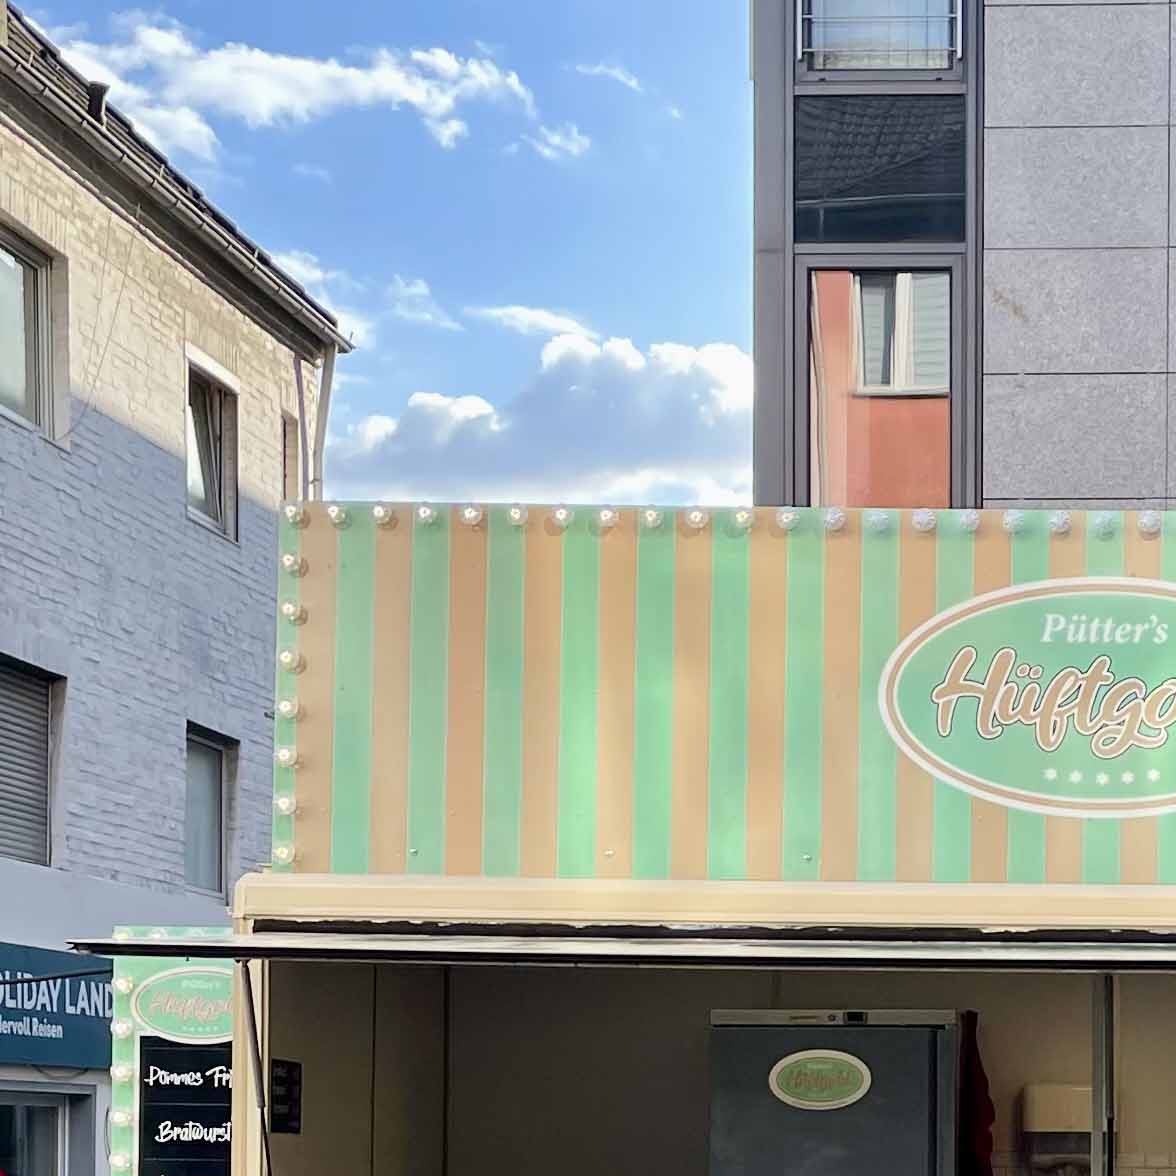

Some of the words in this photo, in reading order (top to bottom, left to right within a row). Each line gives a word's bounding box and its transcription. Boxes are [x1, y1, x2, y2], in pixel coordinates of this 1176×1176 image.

[1041, 614, 1169, 643] Pütter's
[32, 1017, 63, 1038] Reisen
[144, 1065, 204, 1086] Pommes
[154, 1120, 232, 1142] Bratwurst
